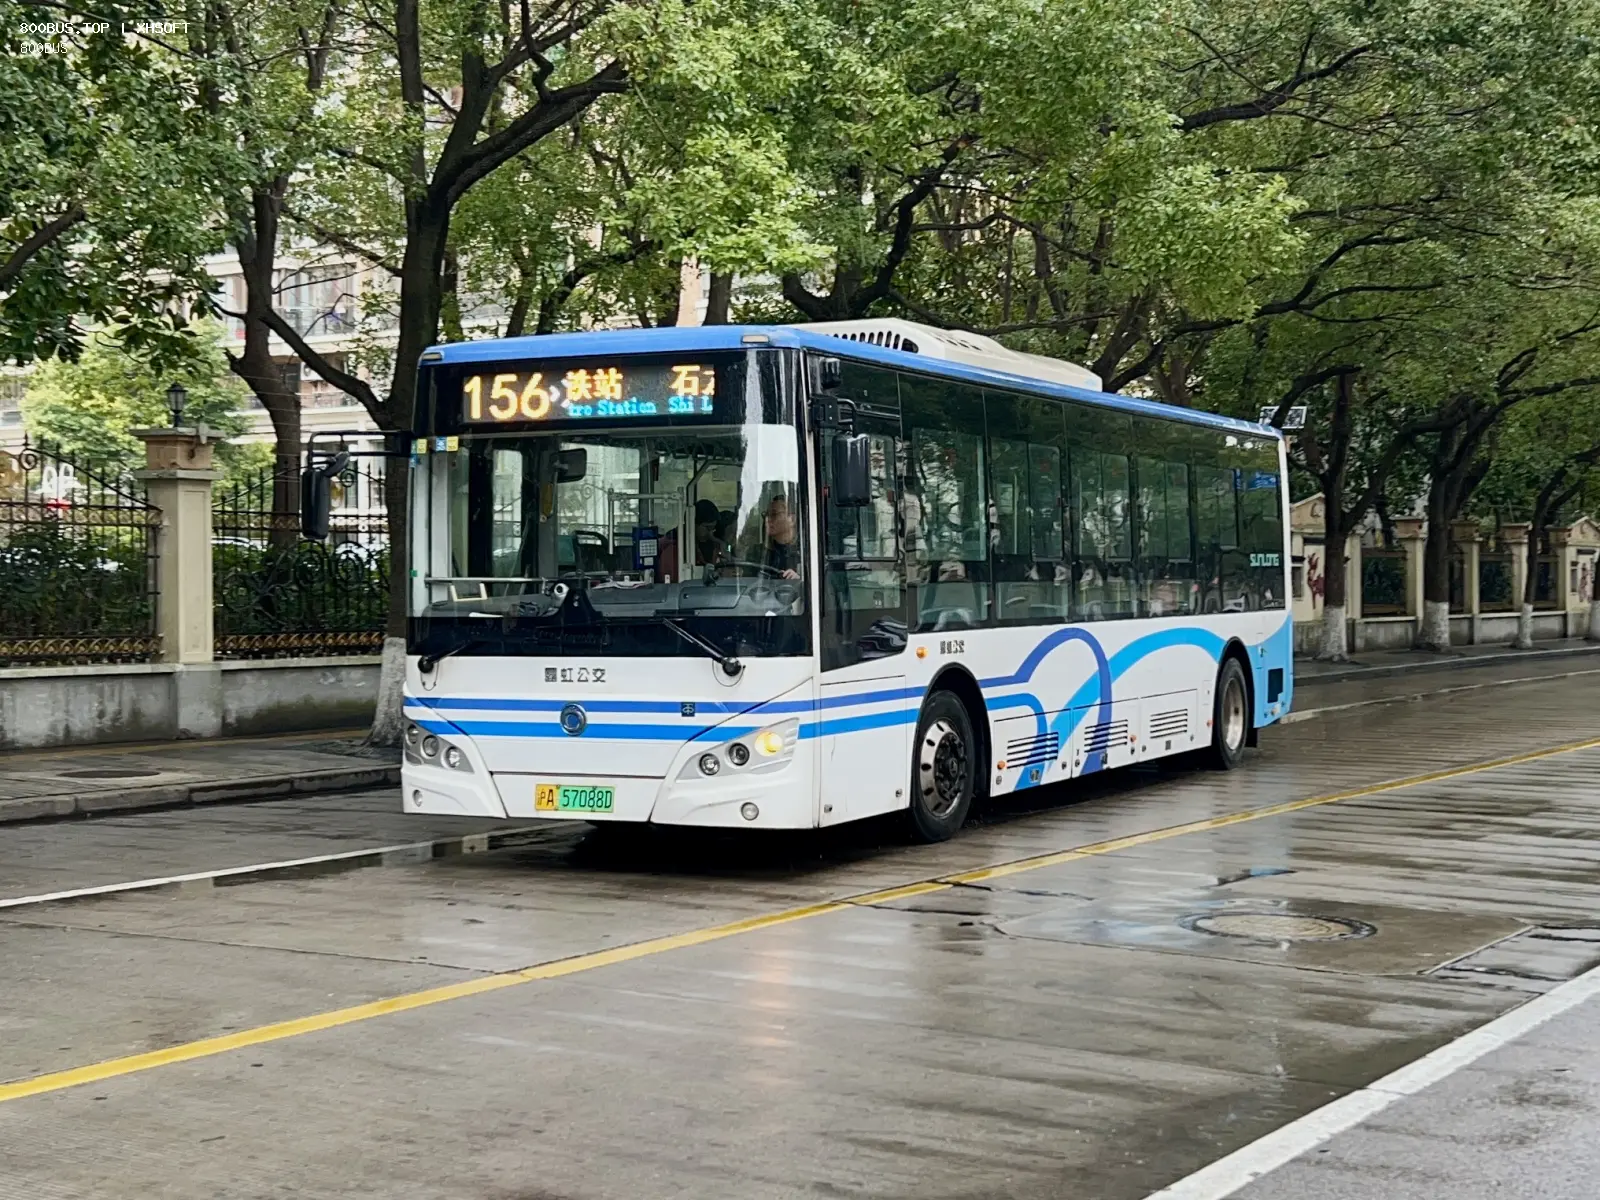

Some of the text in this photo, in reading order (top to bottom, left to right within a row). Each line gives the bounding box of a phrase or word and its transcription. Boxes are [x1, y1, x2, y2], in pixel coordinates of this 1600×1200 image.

[463, 371, 551, 420] 156
[597, 396, 657, 416] Station
[667, 394, 695, 413] Shi
